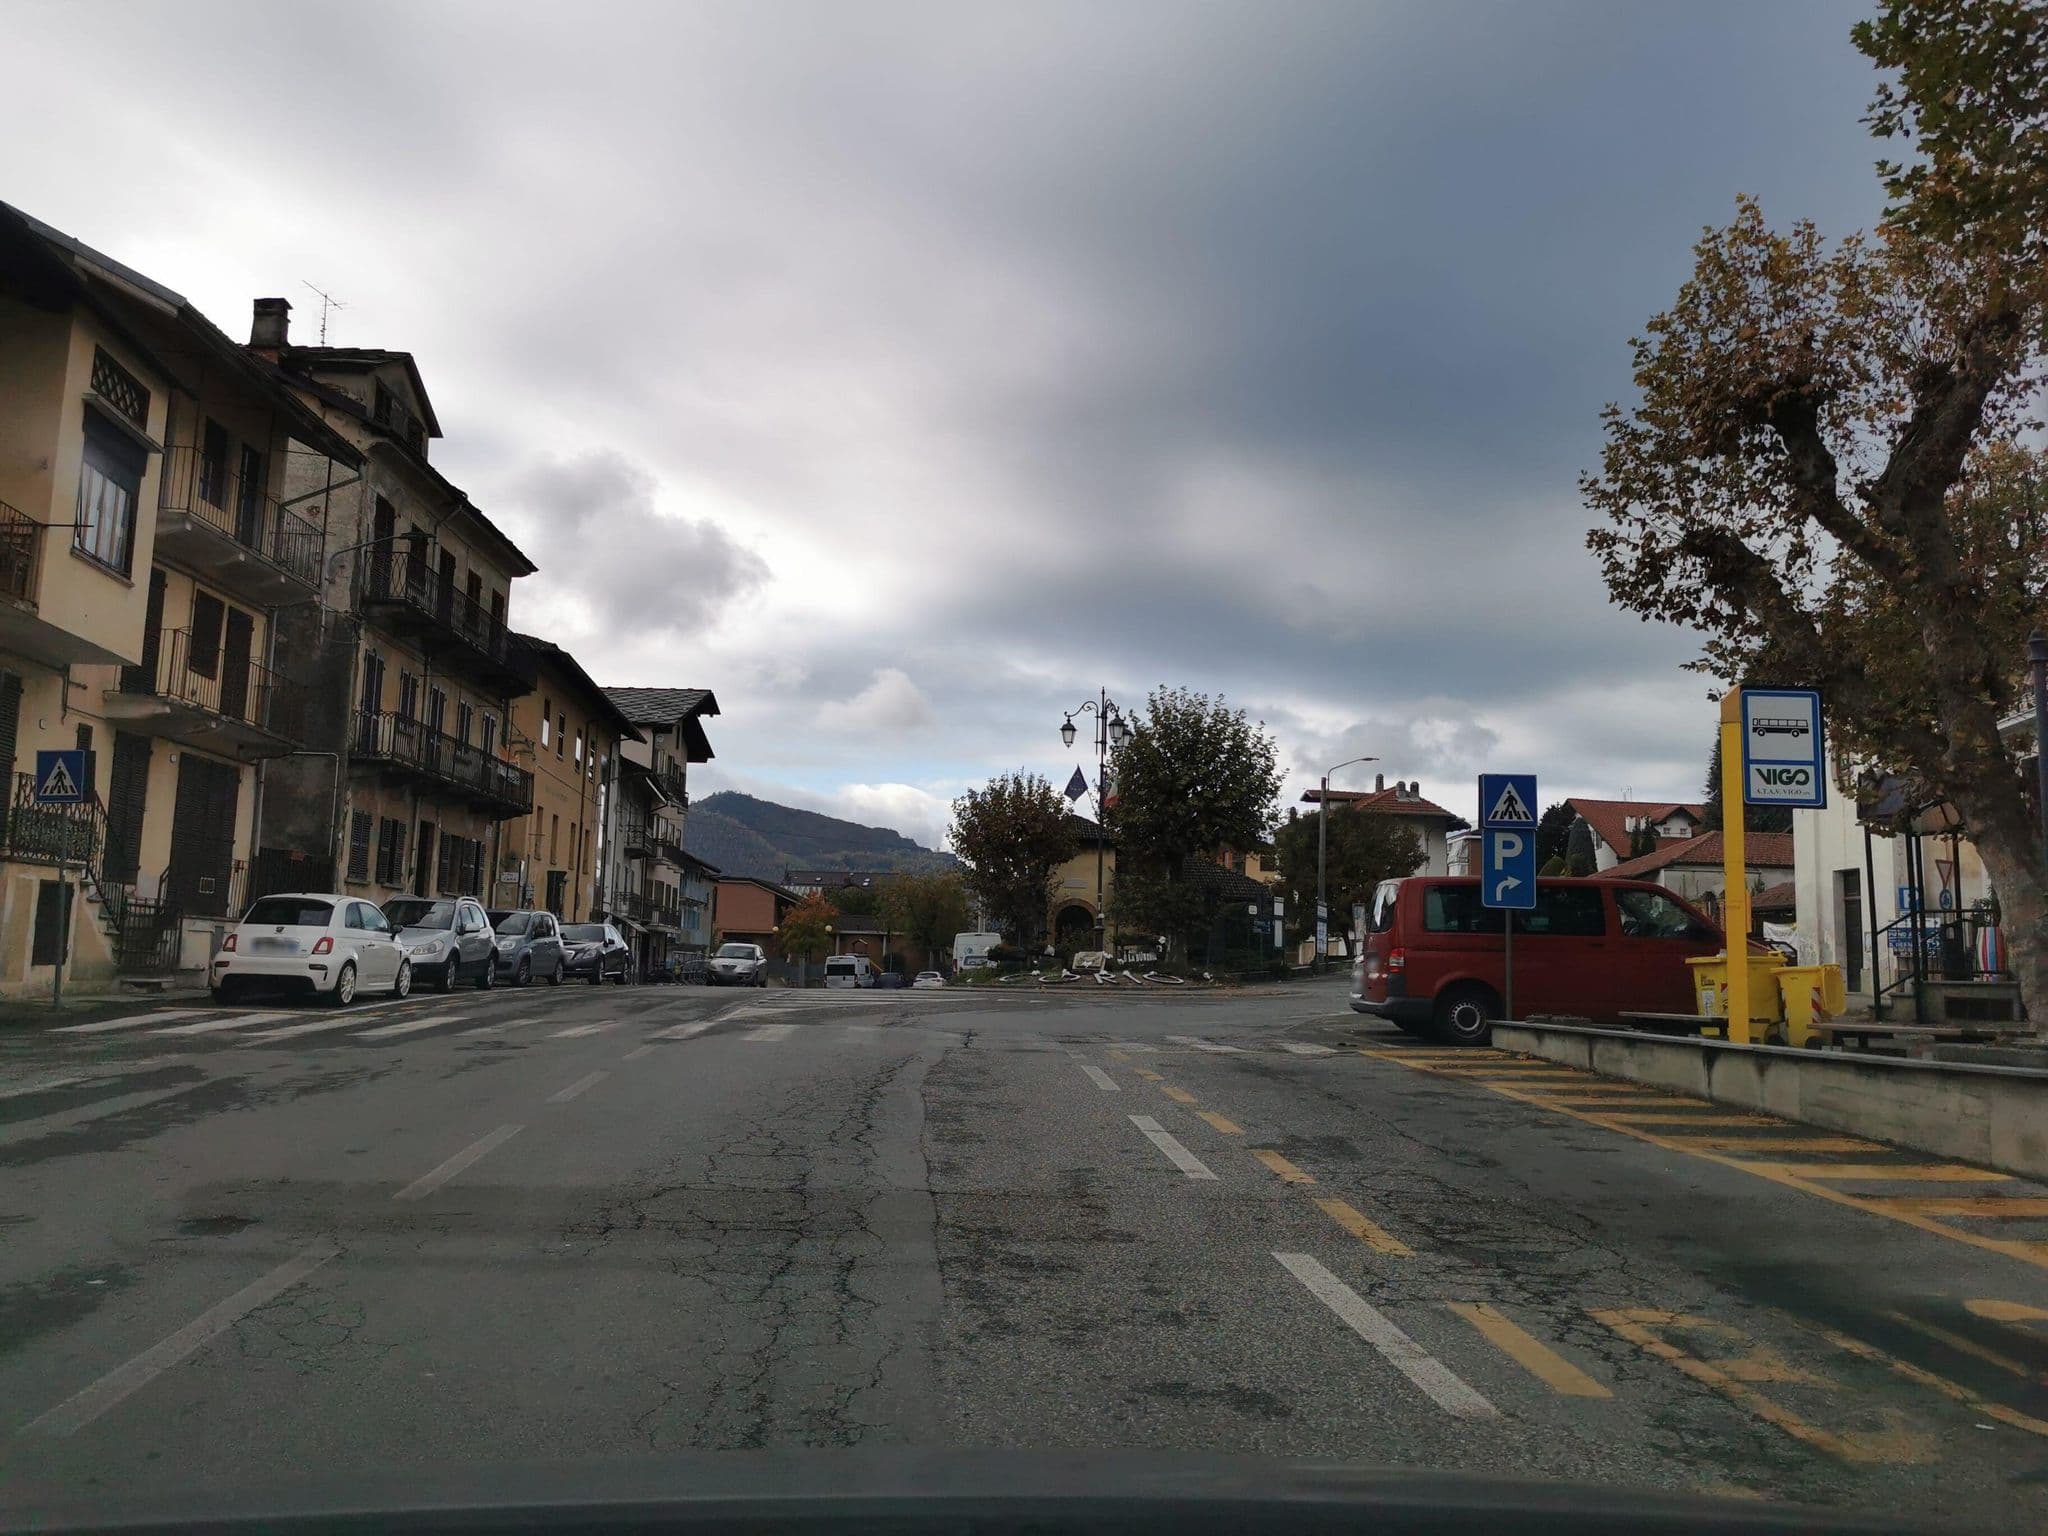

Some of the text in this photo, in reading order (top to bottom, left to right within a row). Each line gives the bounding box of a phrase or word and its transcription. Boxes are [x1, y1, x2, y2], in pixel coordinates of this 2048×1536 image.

[1755, 768, 1810, 786] VIGO
[1494, 832, 1523, 871] P
[999, 969, 1184, 985] CORIO
